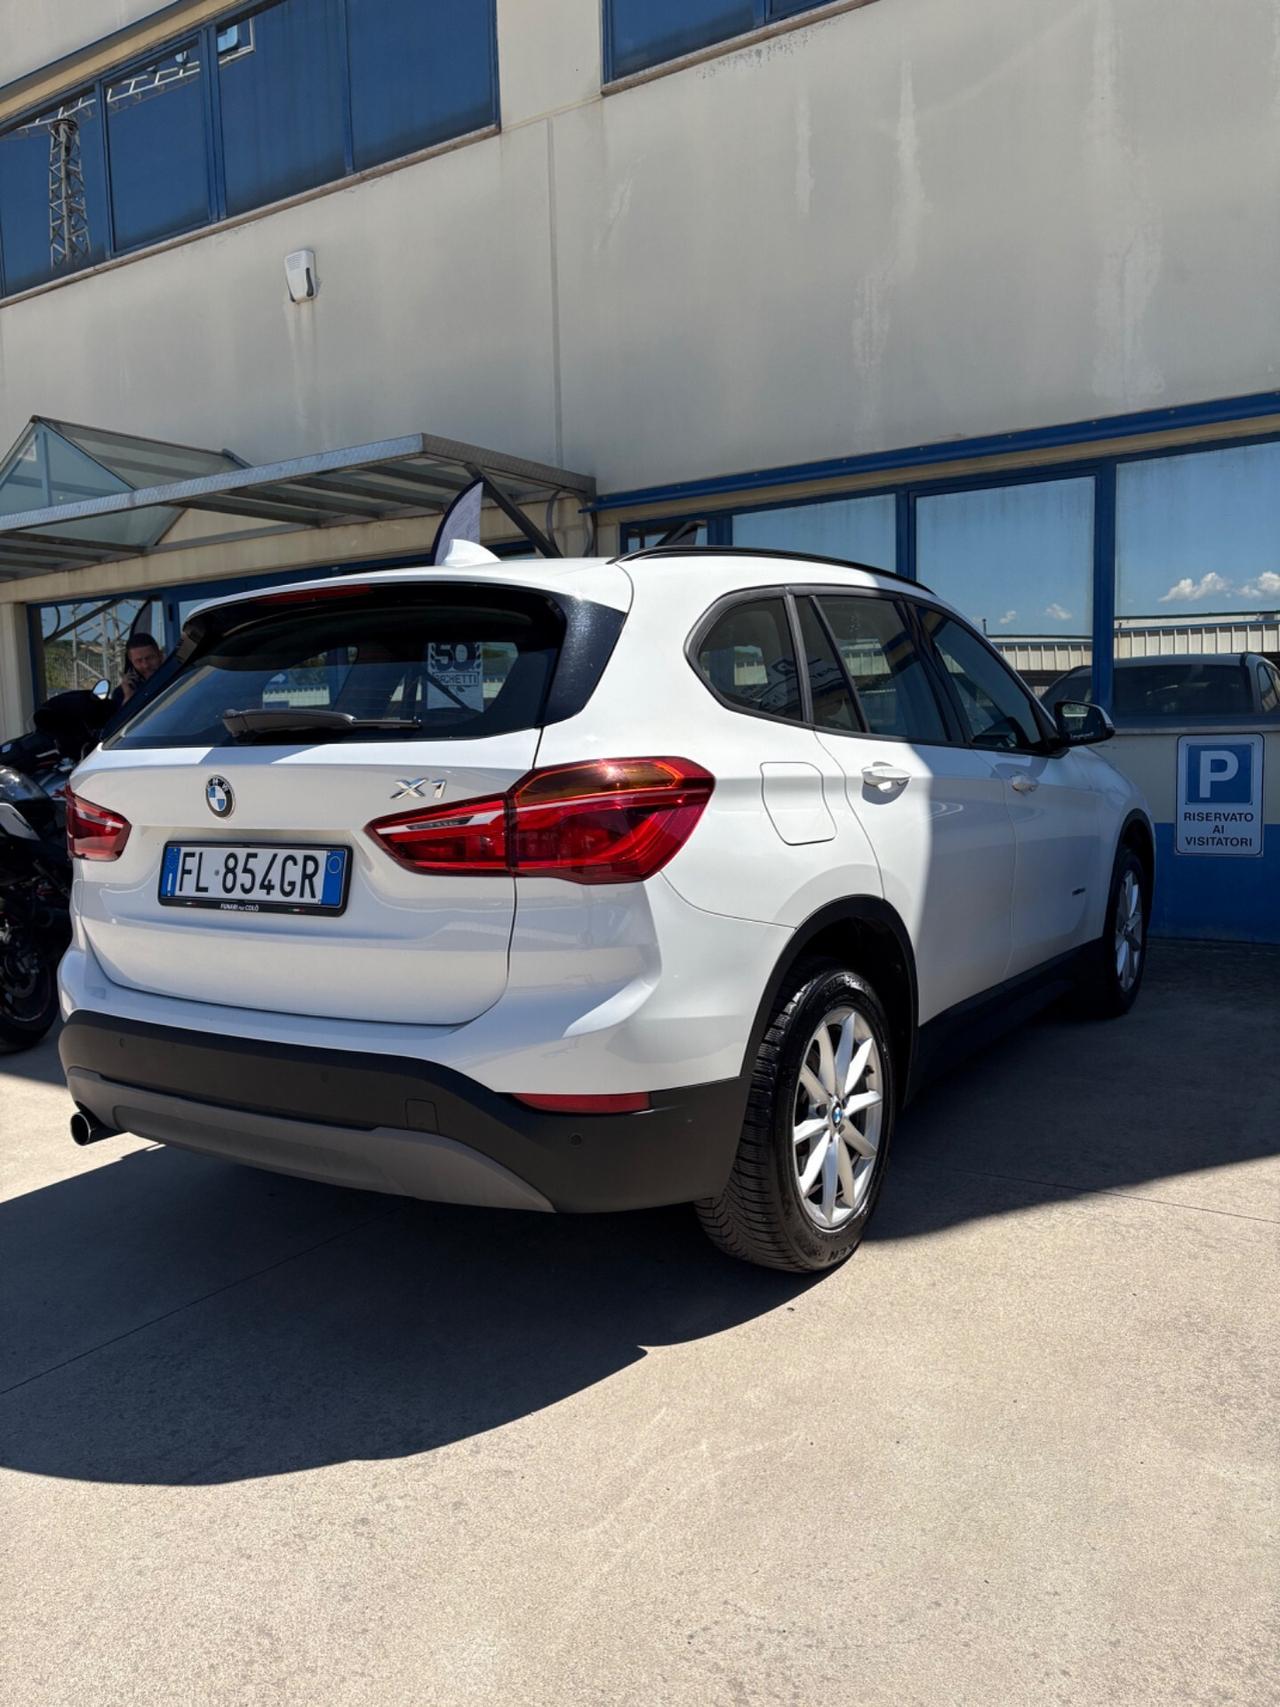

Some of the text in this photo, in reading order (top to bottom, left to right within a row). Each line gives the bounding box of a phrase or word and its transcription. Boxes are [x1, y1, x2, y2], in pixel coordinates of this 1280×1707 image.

[1200, 750, 1239, 798] P
[390, 777, 447, 799] X1
[1183, 812, 1254, 822] RISERVATO
[1212, 825, 1225, 834] AI
[1185, 837, 1253, 847] VISITATORI
[178, 852, 209, 892] FL
[221, 852, 320, 899] 854GR
